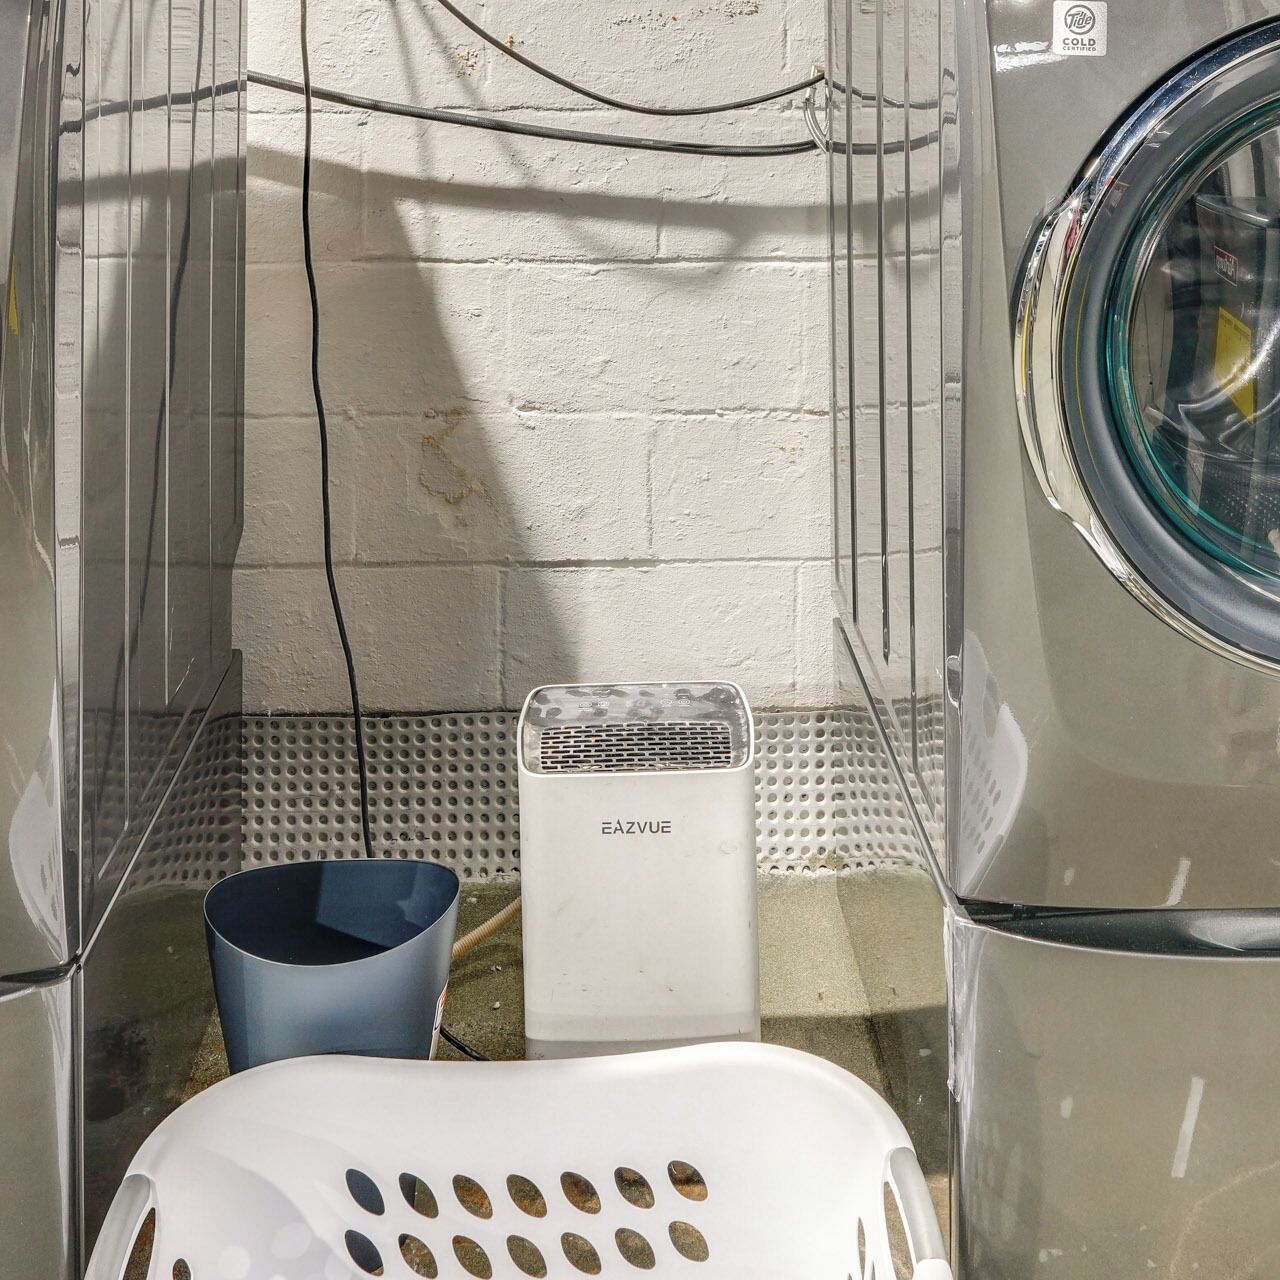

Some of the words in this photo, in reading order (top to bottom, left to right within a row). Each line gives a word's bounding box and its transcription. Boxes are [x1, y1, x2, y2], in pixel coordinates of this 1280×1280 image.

[1067, 11, 1093, 29] Tide
[1062, 38, 1096, 46] COLD
[601, 819, 672, 835] EAZVUE
